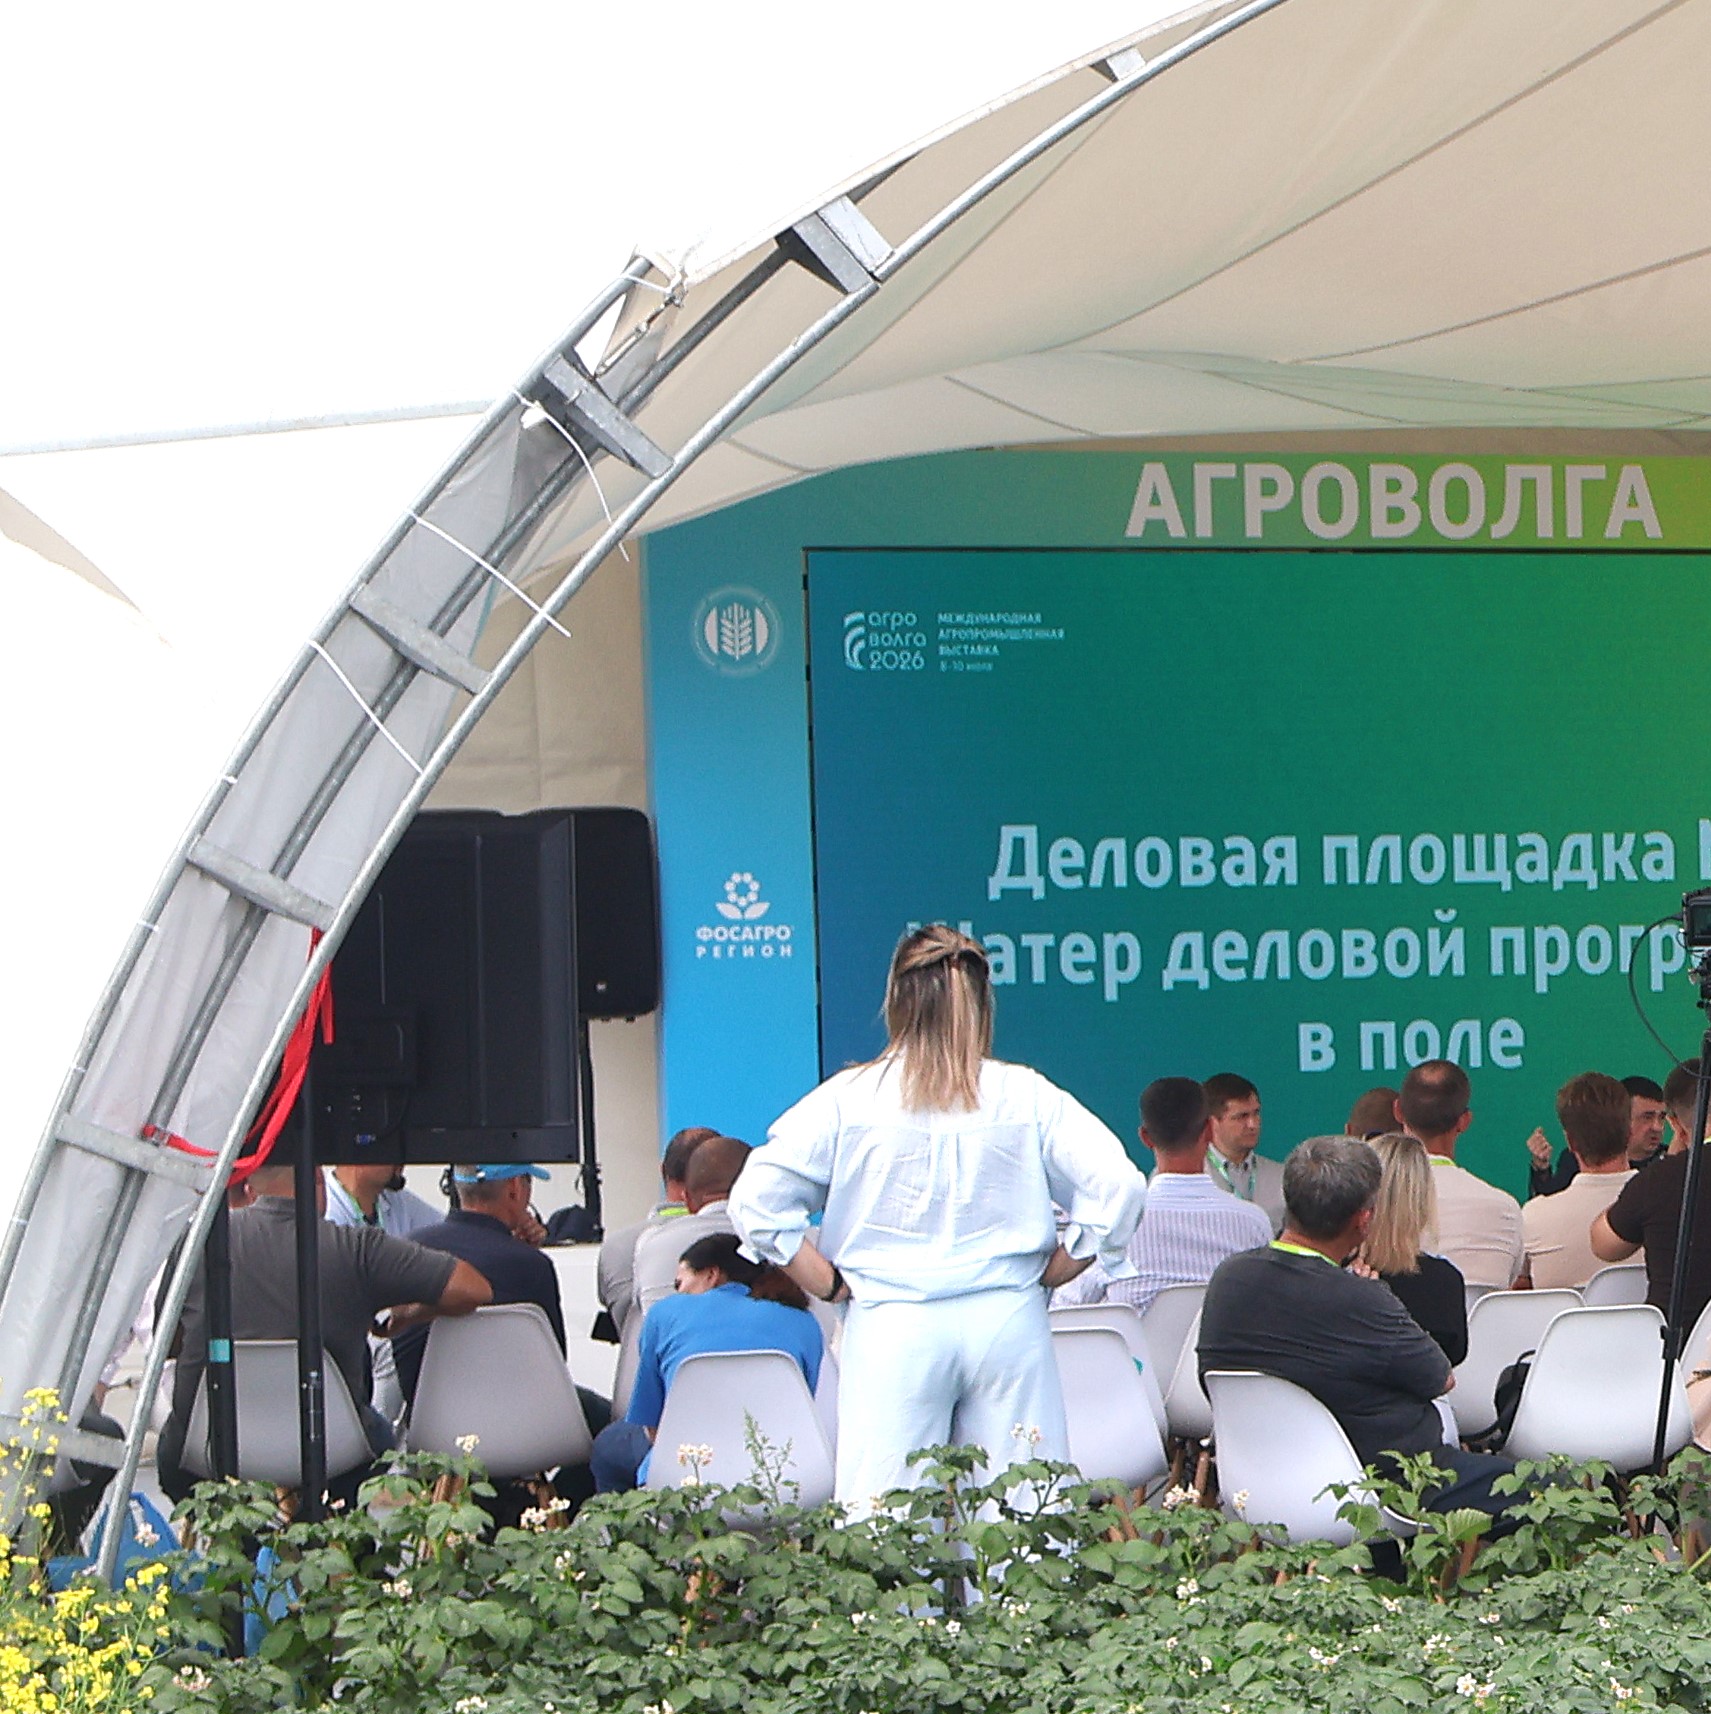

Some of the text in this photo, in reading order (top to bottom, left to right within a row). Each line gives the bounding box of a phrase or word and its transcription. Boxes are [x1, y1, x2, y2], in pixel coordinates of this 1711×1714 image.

[1124, 462, 1663, 539] АГРОВОЛГА
[869, 650, 925, 671] 2026
[987, 824, 1298, 900] Деловая
[1323, 830, 1675, 892] площадка
[696, 924, 792, 941] ФОСАГРО
[696, 944, 793, 958] РЕГИОН
[907, 920, 1141, 1001] атер
[1162, 908, 1465, 991] деловой
[1299, 1017, 1525, 1072] в поле
